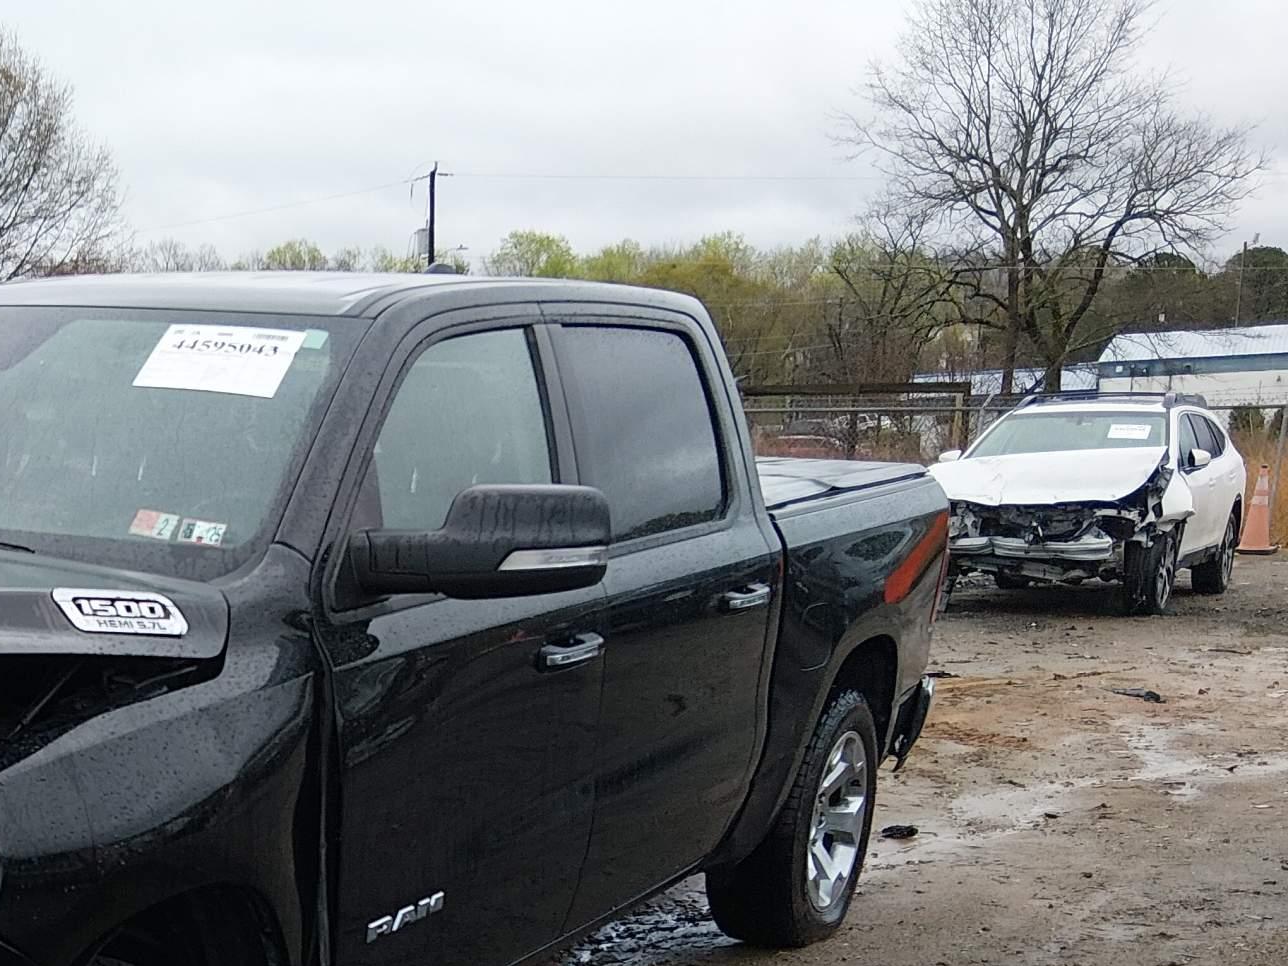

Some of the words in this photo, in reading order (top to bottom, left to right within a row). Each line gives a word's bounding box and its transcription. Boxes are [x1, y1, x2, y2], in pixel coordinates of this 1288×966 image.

[172, 339, 280, 357] 44595043
[75, 599, 166, 619] 1500
[97, 619, 134, 629] HEMI
[138, 620, 167, 631] 5.7L
[366, 890, 445, 944] RAM
